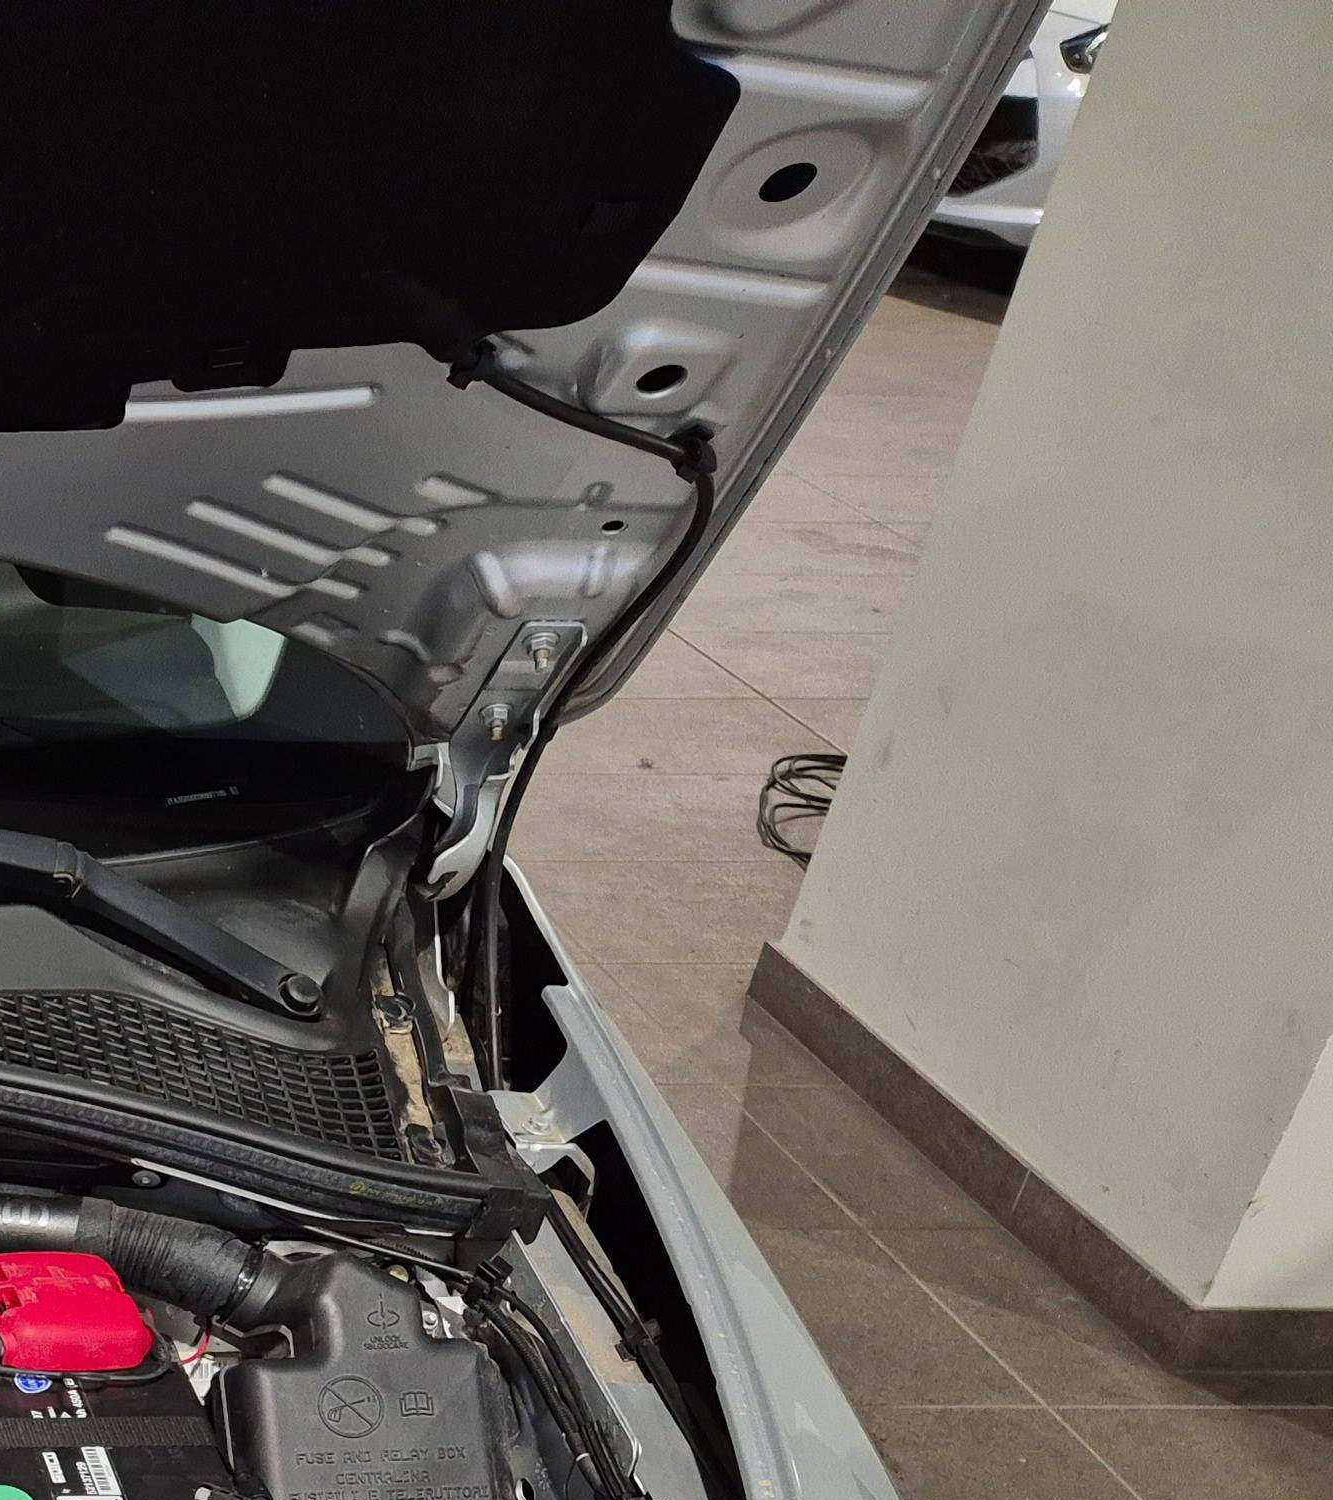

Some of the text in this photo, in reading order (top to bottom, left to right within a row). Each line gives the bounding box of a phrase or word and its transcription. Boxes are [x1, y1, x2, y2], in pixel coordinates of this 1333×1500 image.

[296, 1446, 466, 1466] FUSE AND RELAY BOX
[335, 1470, 431, 1486] CENTRALINA
